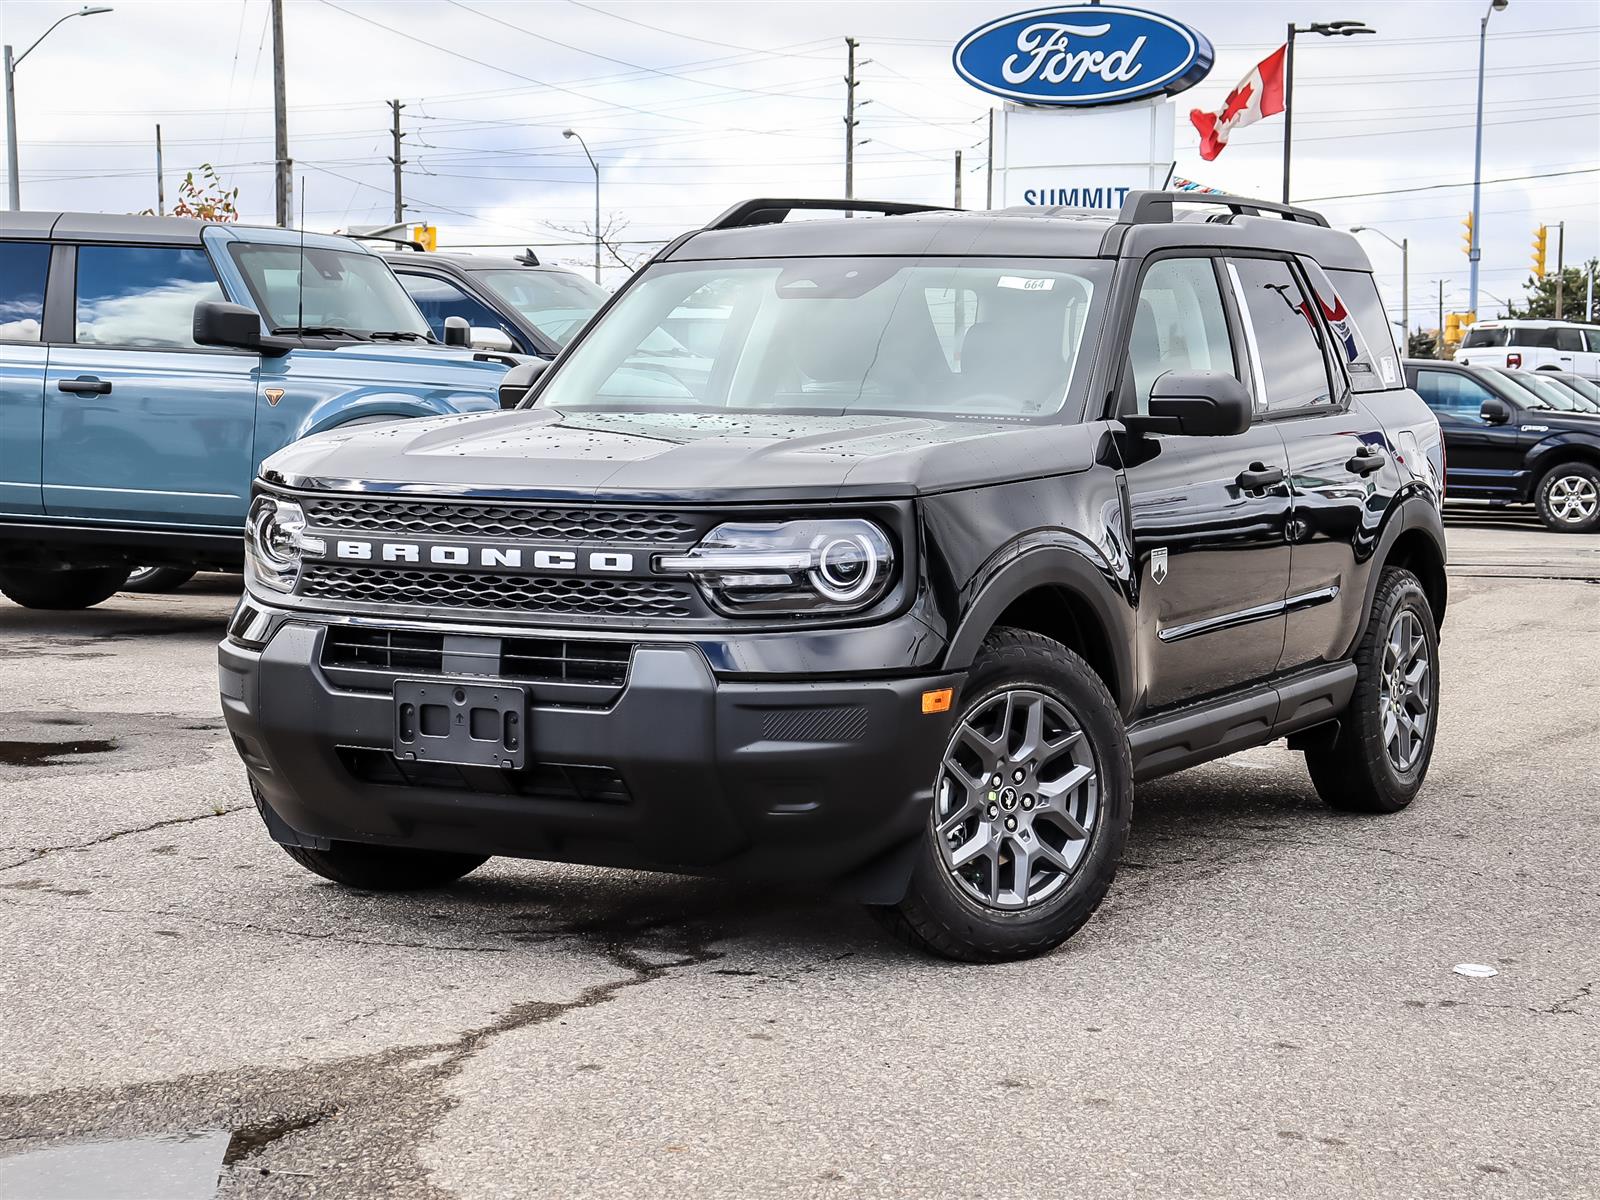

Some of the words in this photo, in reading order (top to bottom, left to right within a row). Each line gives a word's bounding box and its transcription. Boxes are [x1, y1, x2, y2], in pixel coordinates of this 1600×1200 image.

[1001, 22, 1147, 84] Ford
[1024, 187, 1129, 208] SUMMIT
[337, 541, 633, 572] BRONCO
